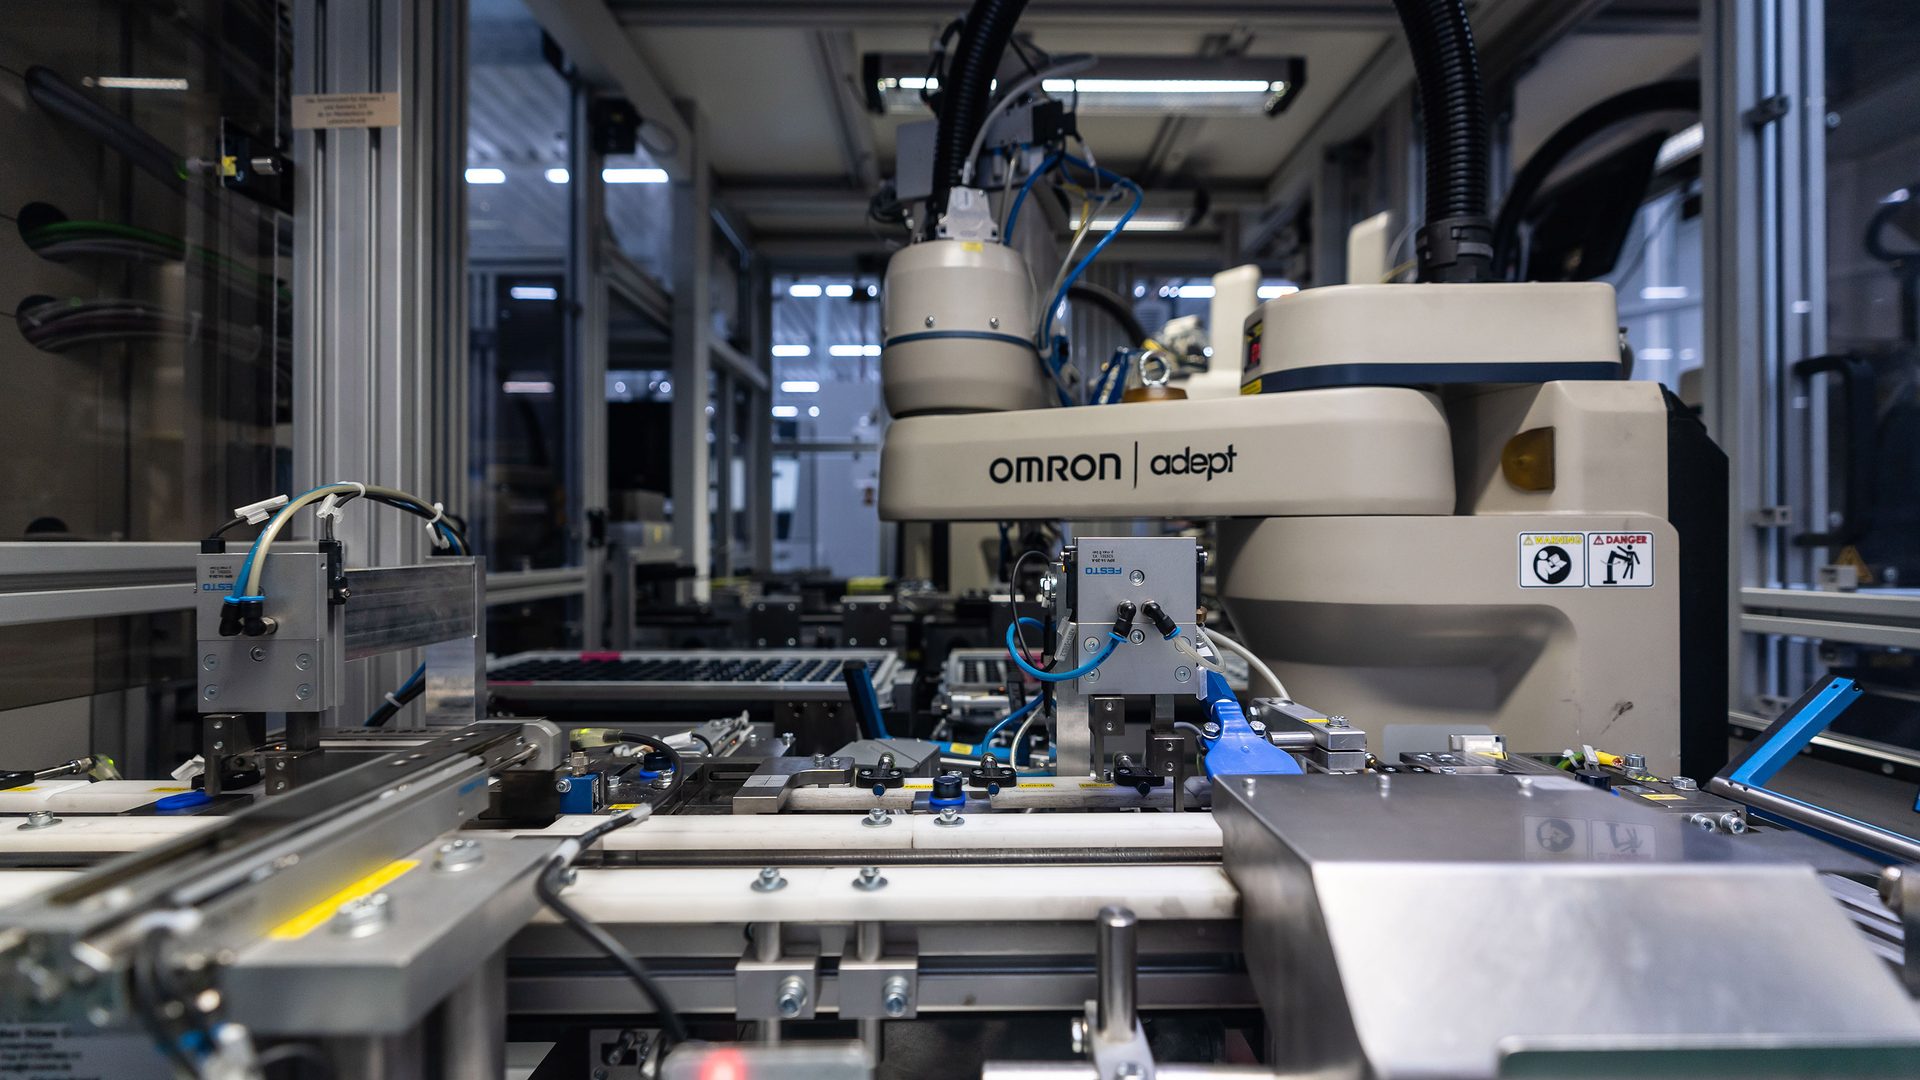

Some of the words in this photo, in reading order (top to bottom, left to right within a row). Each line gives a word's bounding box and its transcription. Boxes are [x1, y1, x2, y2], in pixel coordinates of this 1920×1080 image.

[989, 453, 1122, 484] OMRON
[1150, 444, 1238, 482] adept
[1535, 535, 1582, 545] WARNING
[1606, 535, 1647, 544] DANGER
[1085, 567, 1122, 575] FESTO
